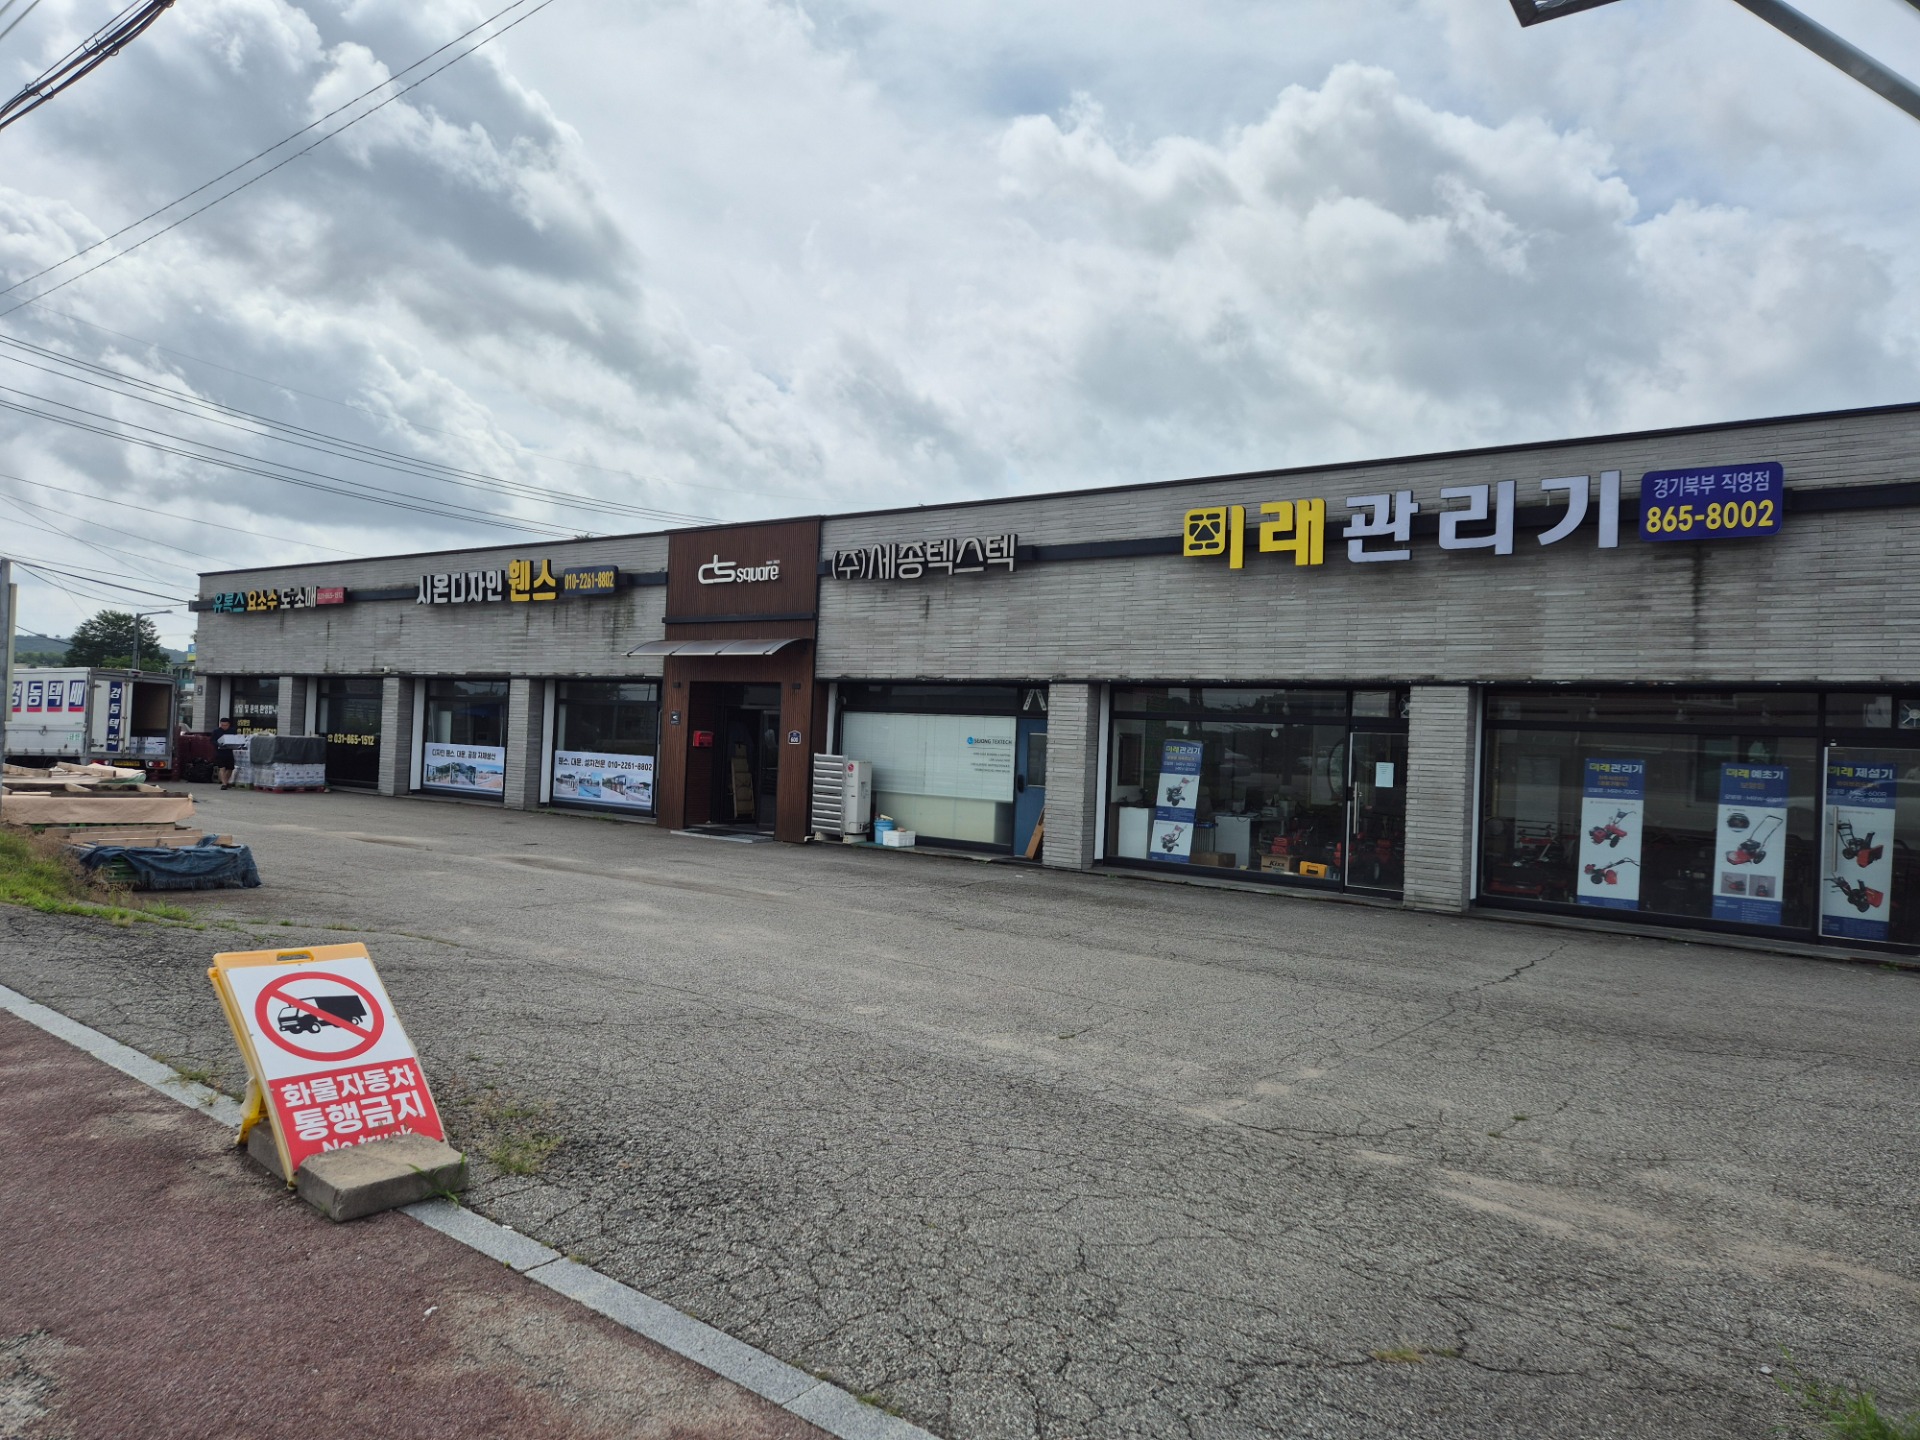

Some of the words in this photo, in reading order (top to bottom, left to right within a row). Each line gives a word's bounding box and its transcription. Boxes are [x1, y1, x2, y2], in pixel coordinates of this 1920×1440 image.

[1654, 475, 1716, 502] 경기북부
[1721, 470, 1770, 495] 직영점
[1646, 499, 1775, 533] 865-8002
[416, 570, 504, 605] 시온디자인
[508, 559, 557, 602] 휀스
[564, 571, 615, 590] 010-2261-8802
[736, 561, 780, 583] square
[213, 591, 245, 613] 유록스
[246, 588, 278, 611] 요소수
[333, 734, 375, 745] 031-865-1512
[607, 761, 653, 771] 010-2261-8802
[1751, 769, 1784, 780] 예초기
[1855, 767, 1893, 779] 제설기
[280, 1064, 415, 1108] 화물자동차
[292, 1089, 426, 1141] 통행금지
